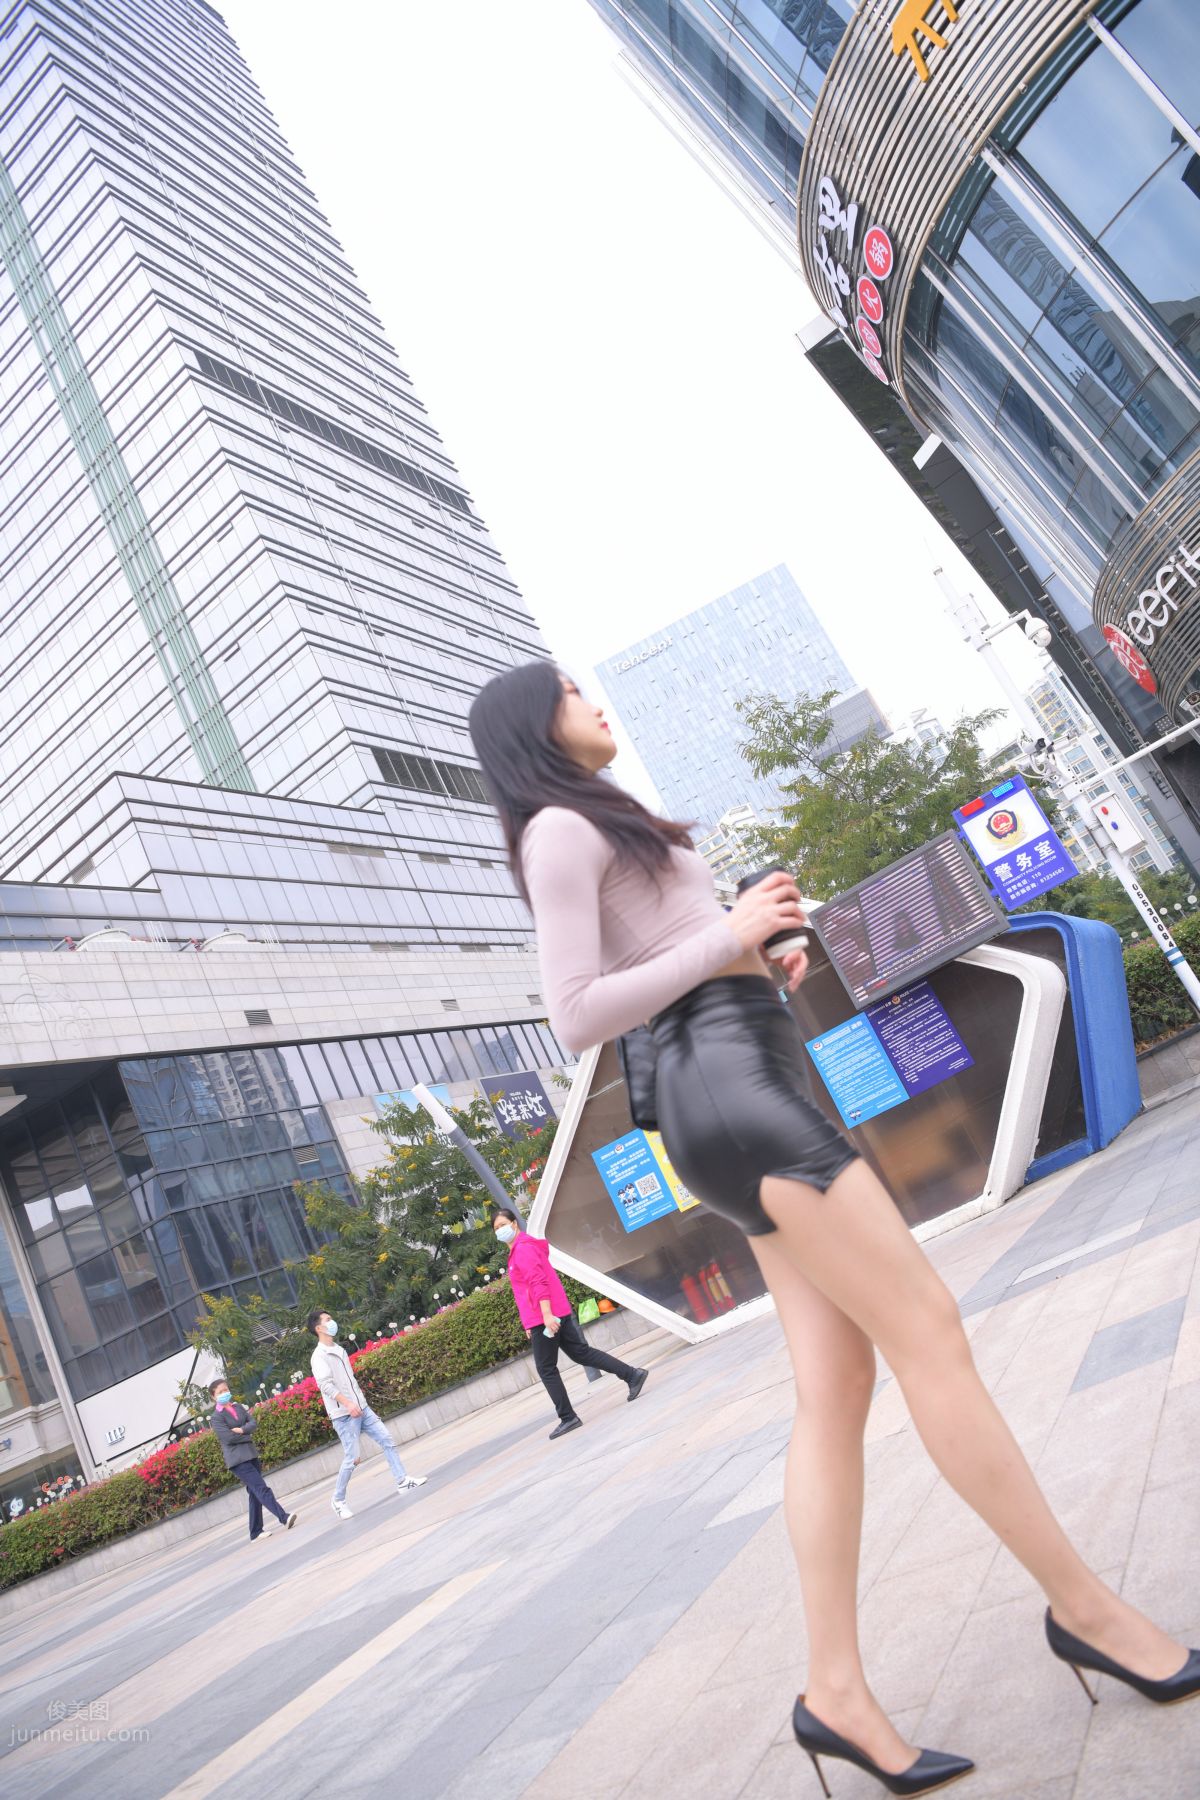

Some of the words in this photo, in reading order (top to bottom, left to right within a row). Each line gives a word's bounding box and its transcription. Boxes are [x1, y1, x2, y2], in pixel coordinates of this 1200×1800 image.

[613, 637, 673, 676] Tencent
[993, 840, 1056, 882] 警务室
[1132, 883, 1174, 948] 05530084
